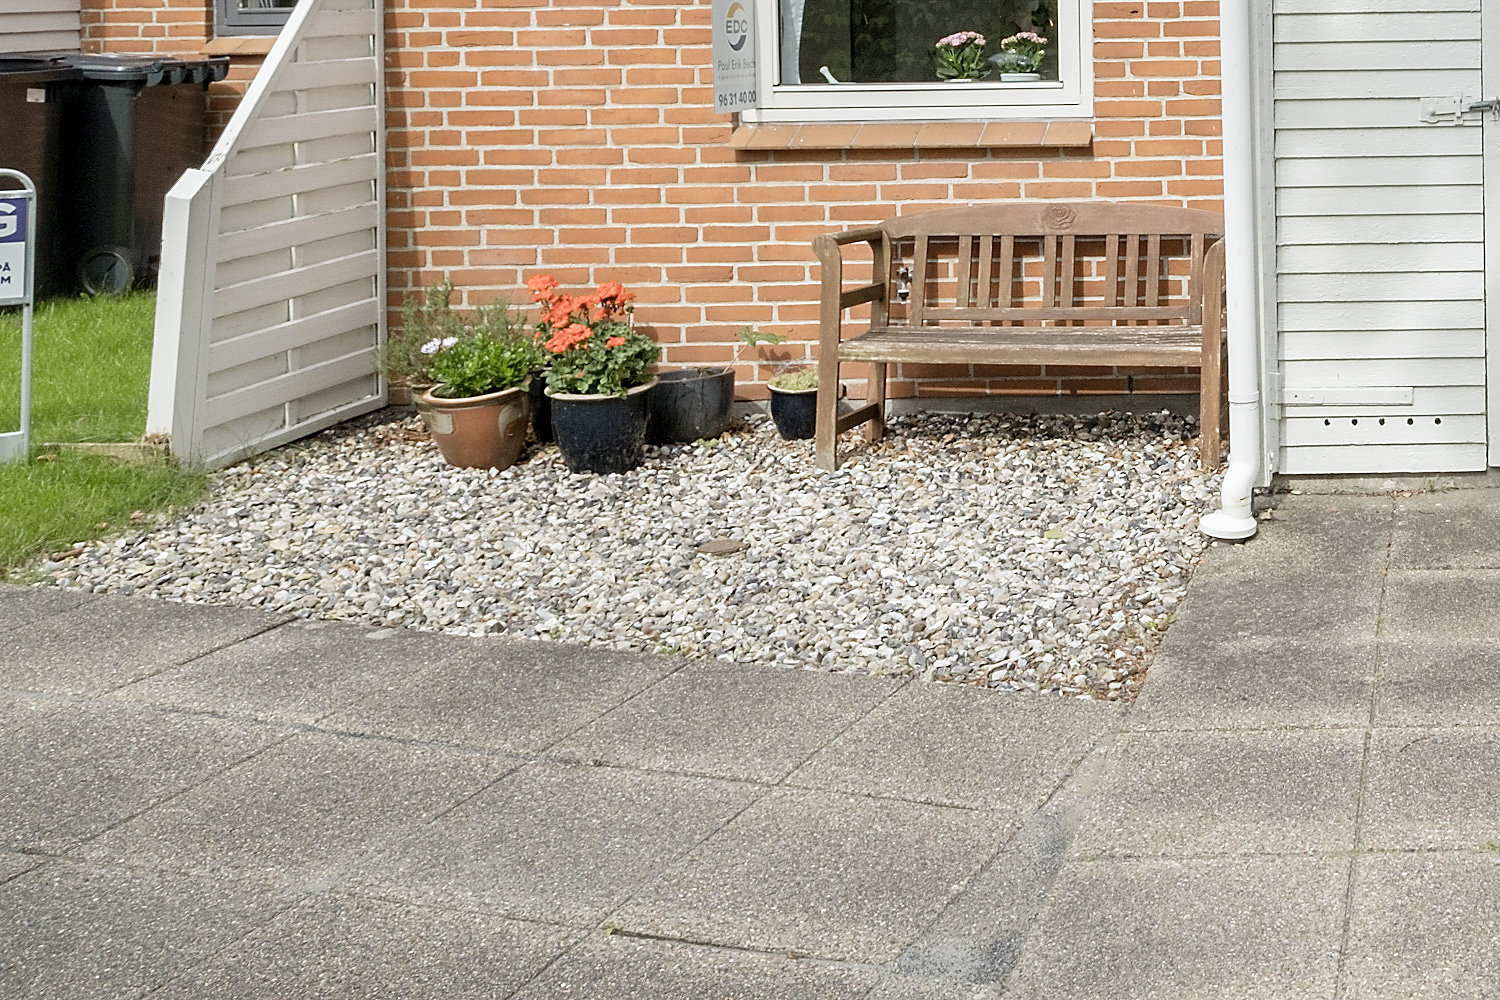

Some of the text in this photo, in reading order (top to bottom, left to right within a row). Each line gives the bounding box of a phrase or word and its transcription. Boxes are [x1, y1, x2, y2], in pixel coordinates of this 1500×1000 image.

[726, 20, 748, 34] EDC
[719, 90, 757, 107] 96 31 40 00
